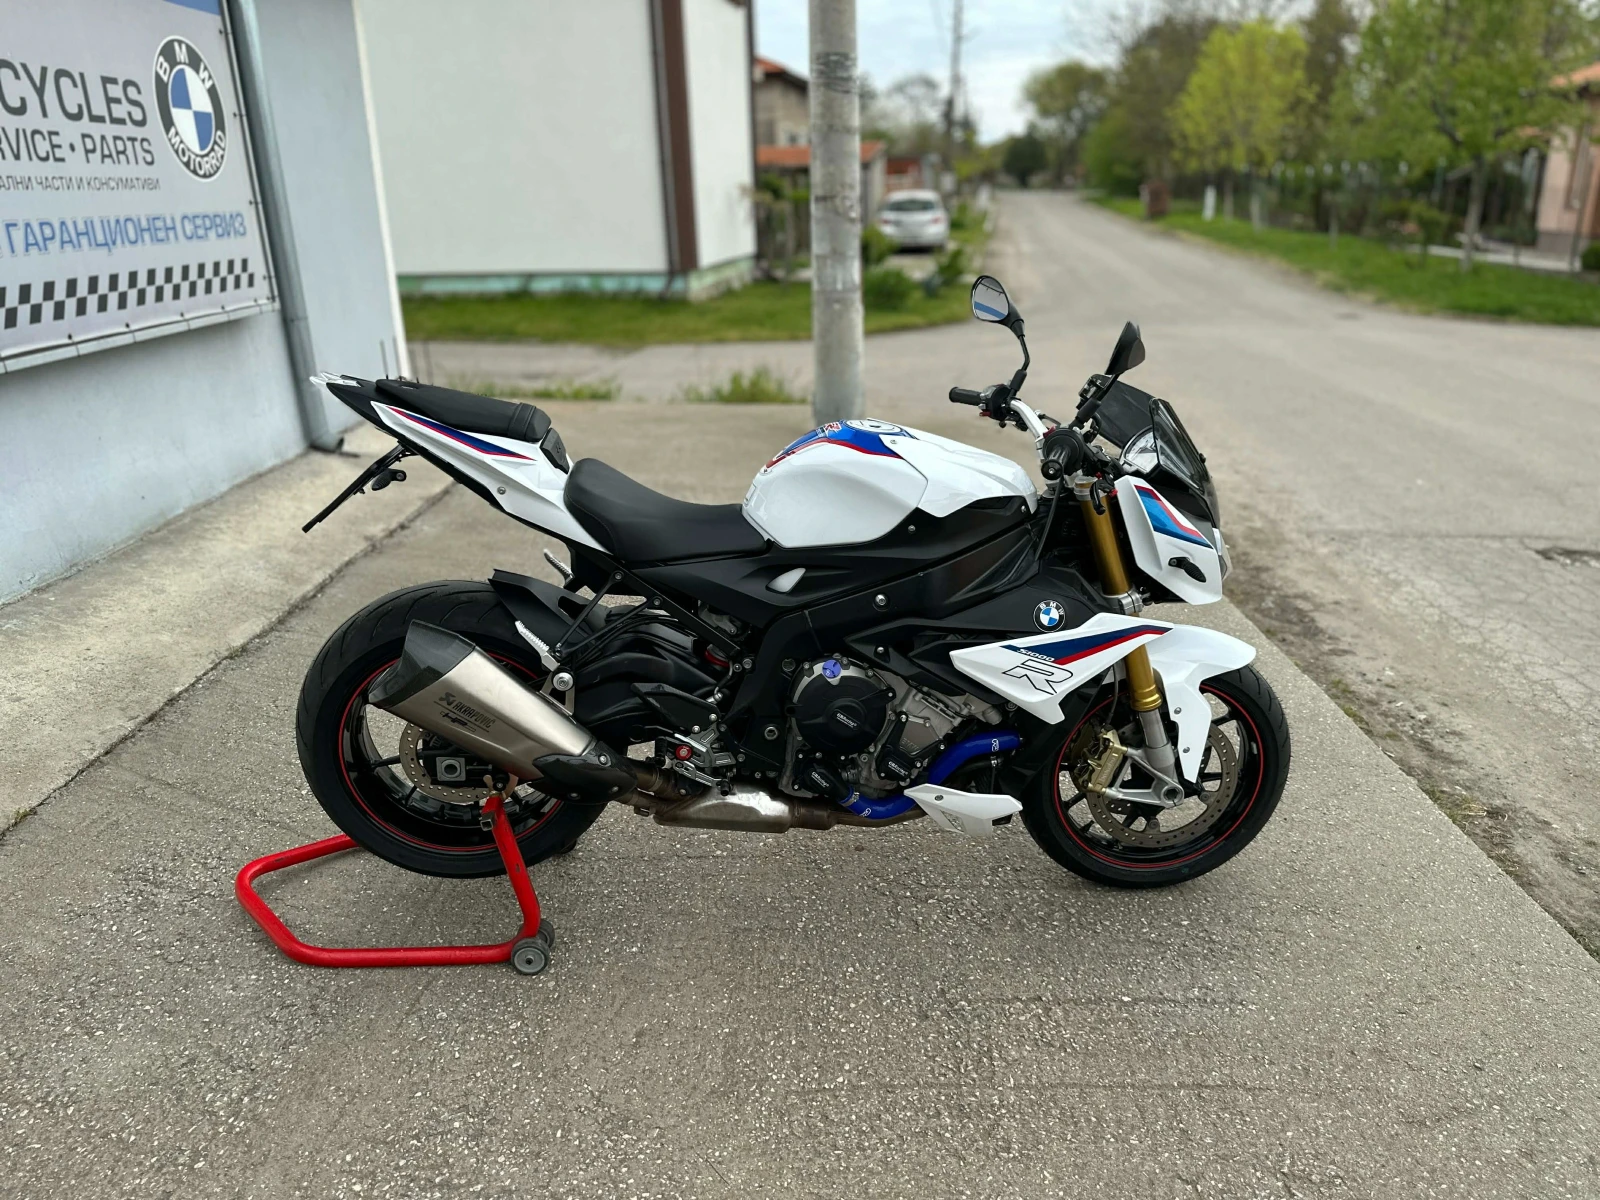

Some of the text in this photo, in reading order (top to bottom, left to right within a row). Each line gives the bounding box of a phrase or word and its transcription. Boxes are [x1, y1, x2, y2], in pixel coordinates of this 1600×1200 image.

[0, 59, 148, 128] CYCLES
[81, 133, 155, 166] PARTS
[168, 126, 226, 176] MOTORRAD
[35, 175, 75, 191] ЧАСТИ
[75, 175, 86, 191] И
[87, 176, 161, 191] КОНСУМАТИВИ
[5, 212, 247, 255] ГАРАНЦИОНЕН СЕРВИЗ
[1039, 601, 1065, 616] BMW
[1002, 659, 1073, 695] R
